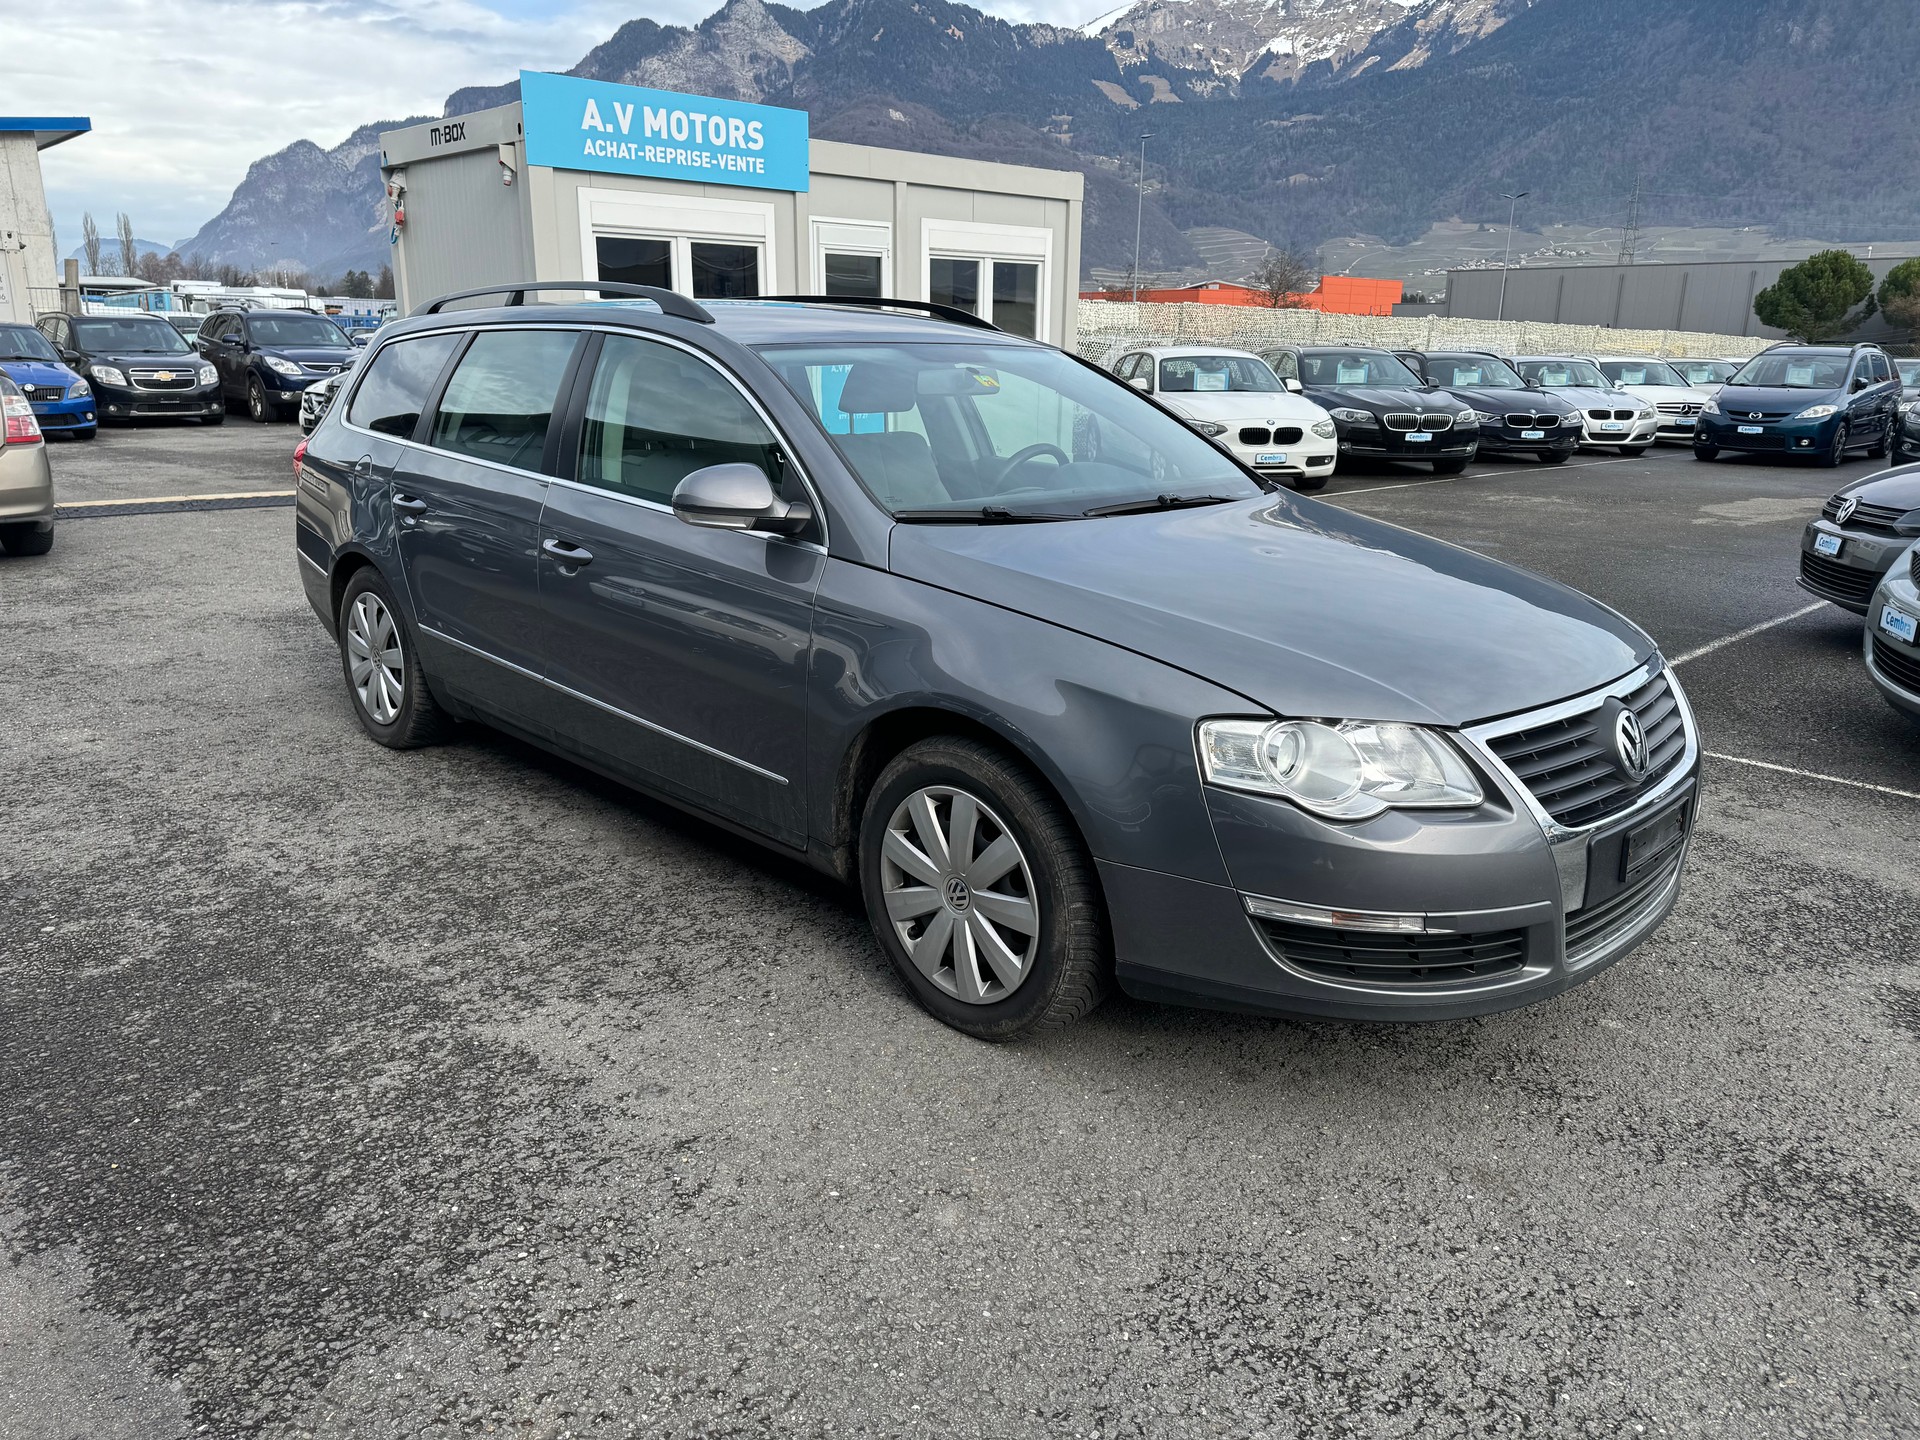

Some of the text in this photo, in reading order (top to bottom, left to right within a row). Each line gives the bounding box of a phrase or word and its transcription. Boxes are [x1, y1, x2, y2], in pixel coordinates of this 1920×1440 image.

[581, 98, 764, 151] A.V MOTORS
[583, 138, 765, 174] ACHAT-REPRISE-VENTE
[1818, 536, 1837, 551] Cembra
[1885, 611, 1912, 636] Cembra
